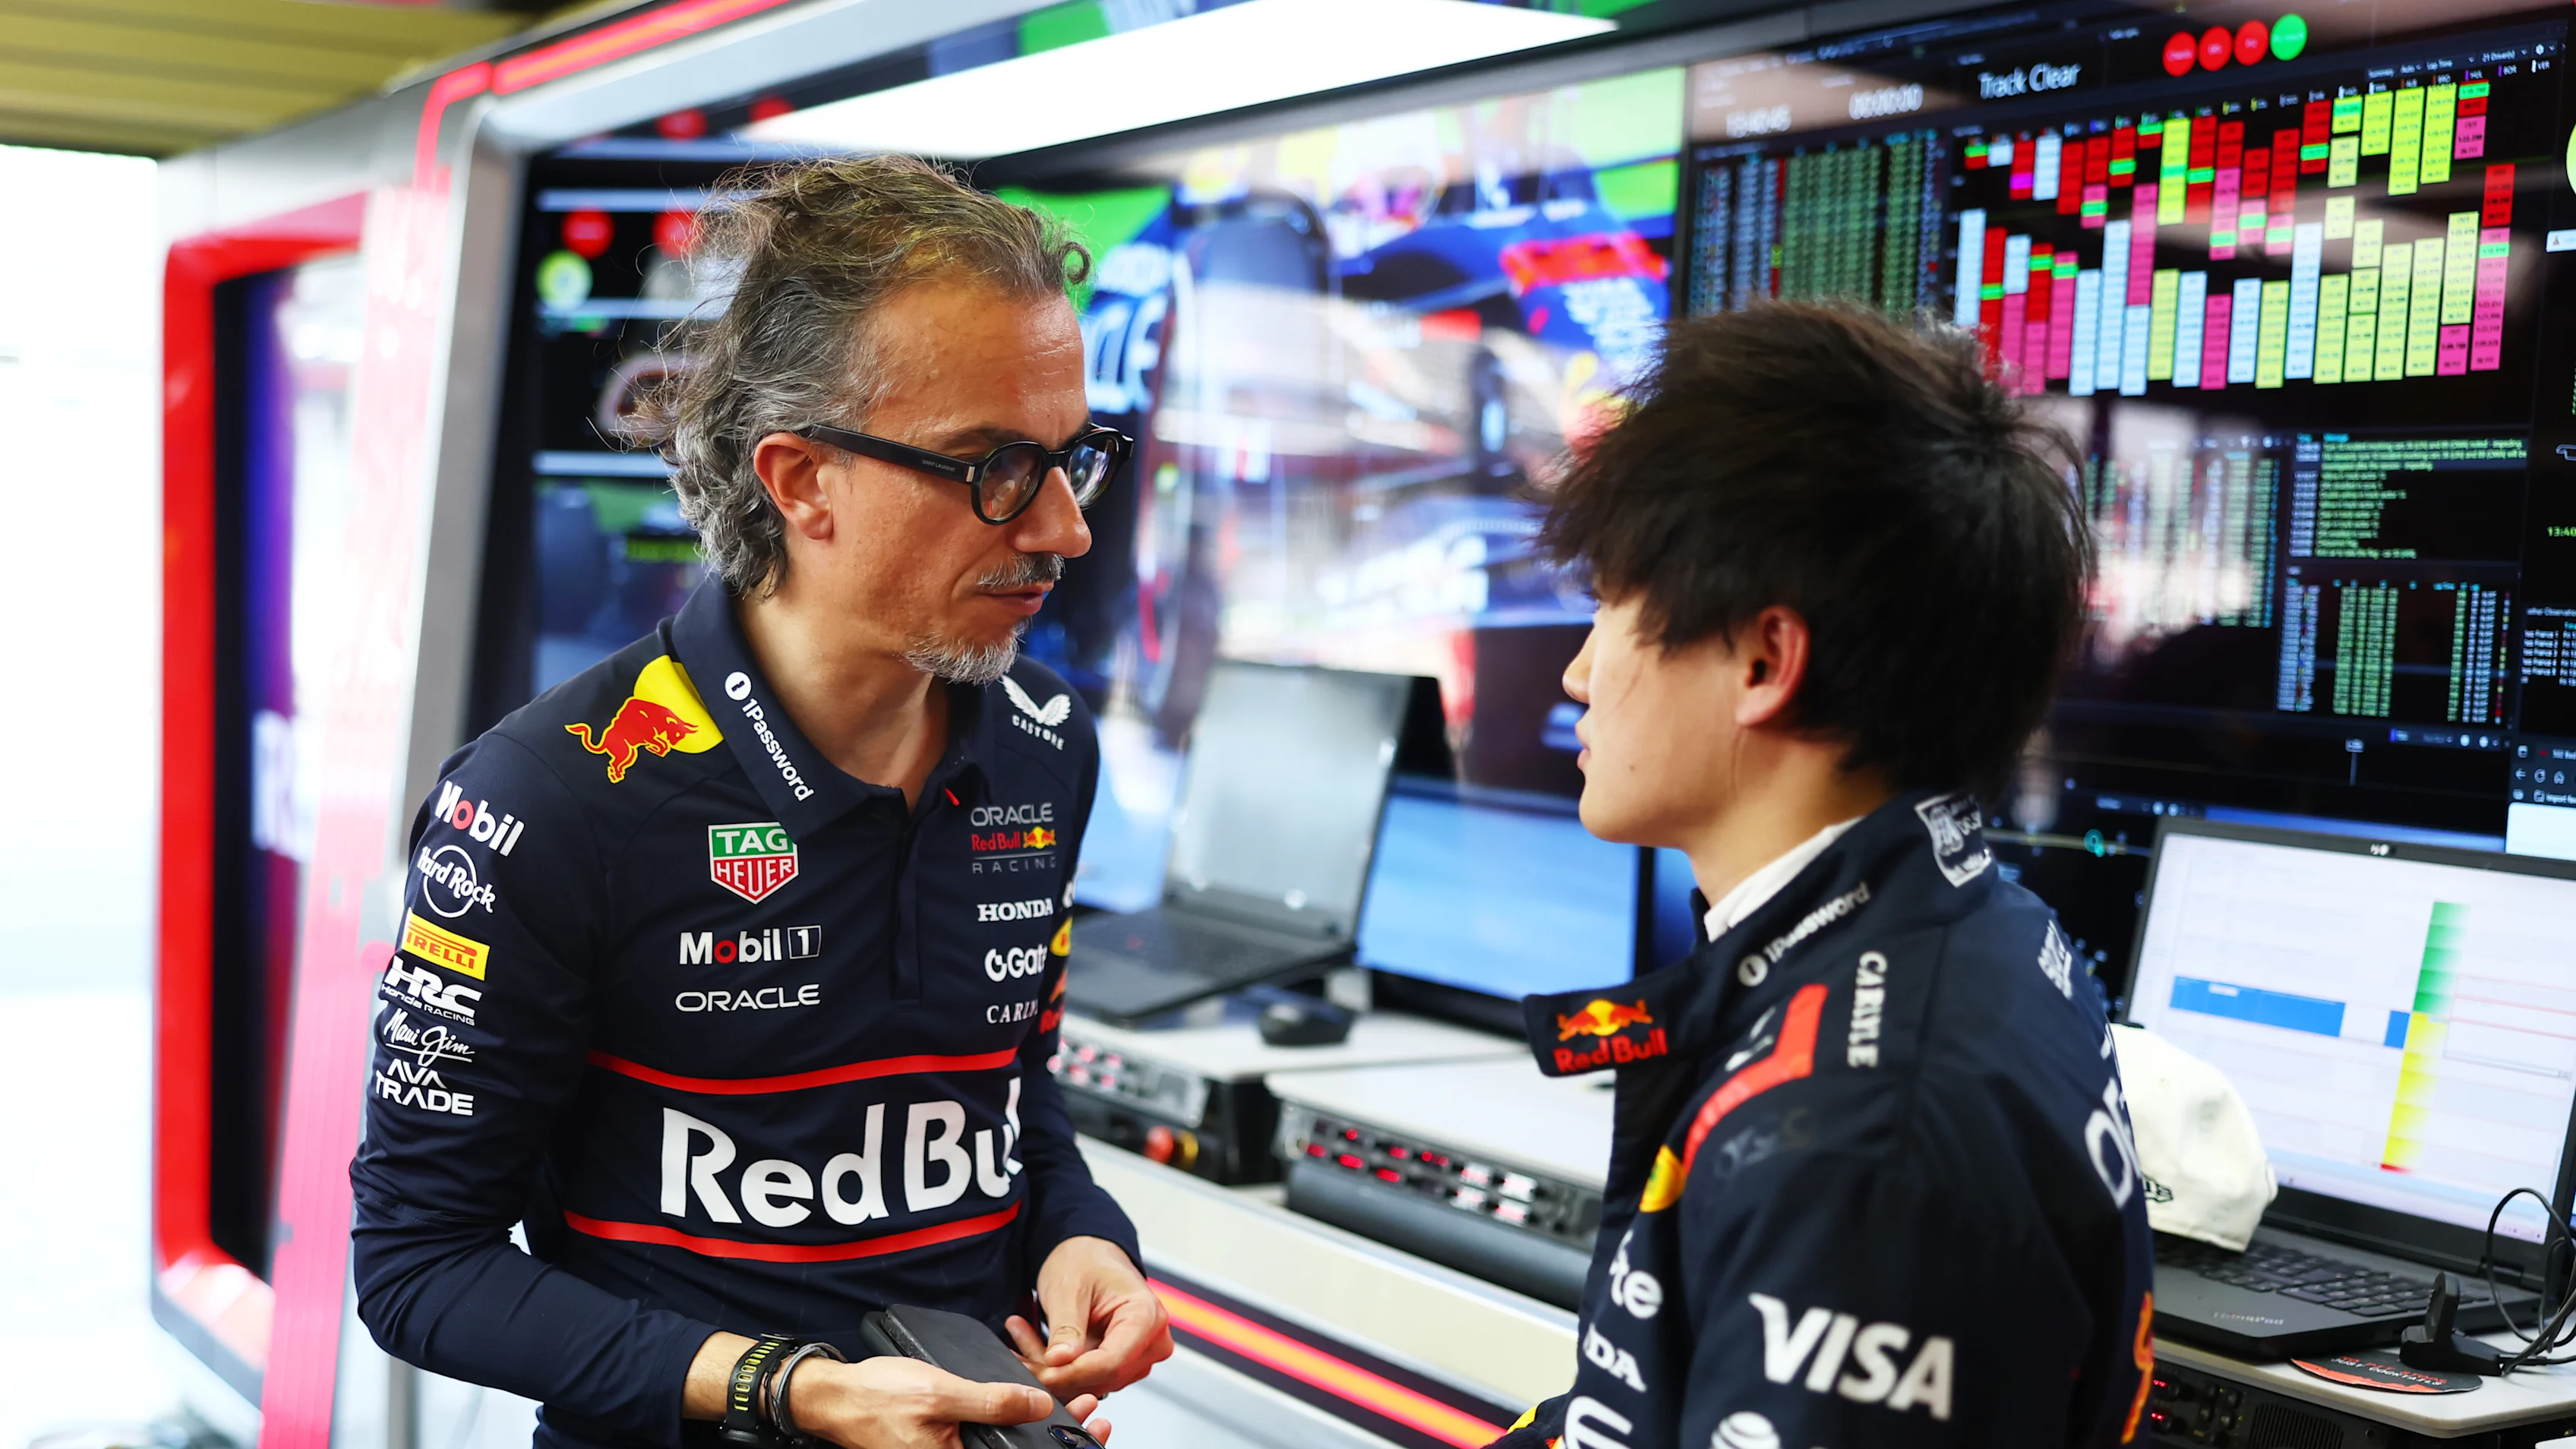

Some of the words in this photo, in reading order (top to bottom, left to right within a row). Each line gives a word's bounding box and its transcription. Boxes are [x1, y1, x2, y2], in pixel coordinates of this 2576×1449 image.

[1978, 67, 2028, 99] Track
[2028, 62, 2082, 92] Clear
[742, 697, 815, 802] 1Password
[1012, 714, 1065, 751] CASTORE
[434, 780, 525, 857] Mobil
[971, 803, 1054, 826] ORACLE
[716, 828, 788, 854] TAG
[971, 832, 996, 851] Red
[997, 832, 1021, 850] Bull
[417, 846, 454, 884] Hard
[448, 867, 496, 913] Rock
[715, 859, 793, 897] HEUER
[972, 857, 1056, 873] RACING
[977, 898, 1054, 922] HONDA
[1763, 882, 1870, 963] 1Password
[679, 929, 782, 964] Mobil
[381, 983, 422, 1010] Honda
[423, 1003, 475, 1026] RACING
[384, 955, 482, 1018] HRC
[675, 983, 822, 1012] ORACLE
[383, 1008, 420, 1046] Maui
[418, 1025, 475, 1067] Jim
[1553, 1037, 1612, 1074] Red
[1612, 1028, 1667, 1065] Bull
[375, 1069, 475, 1116] TRADE
[387, 1058, 448, 1089] AVA
[661, 1103, 890, 1228] Red
[903, 1077, 1023, 1214] Bul
[1748, 1293, 1953, 1421] VISA
